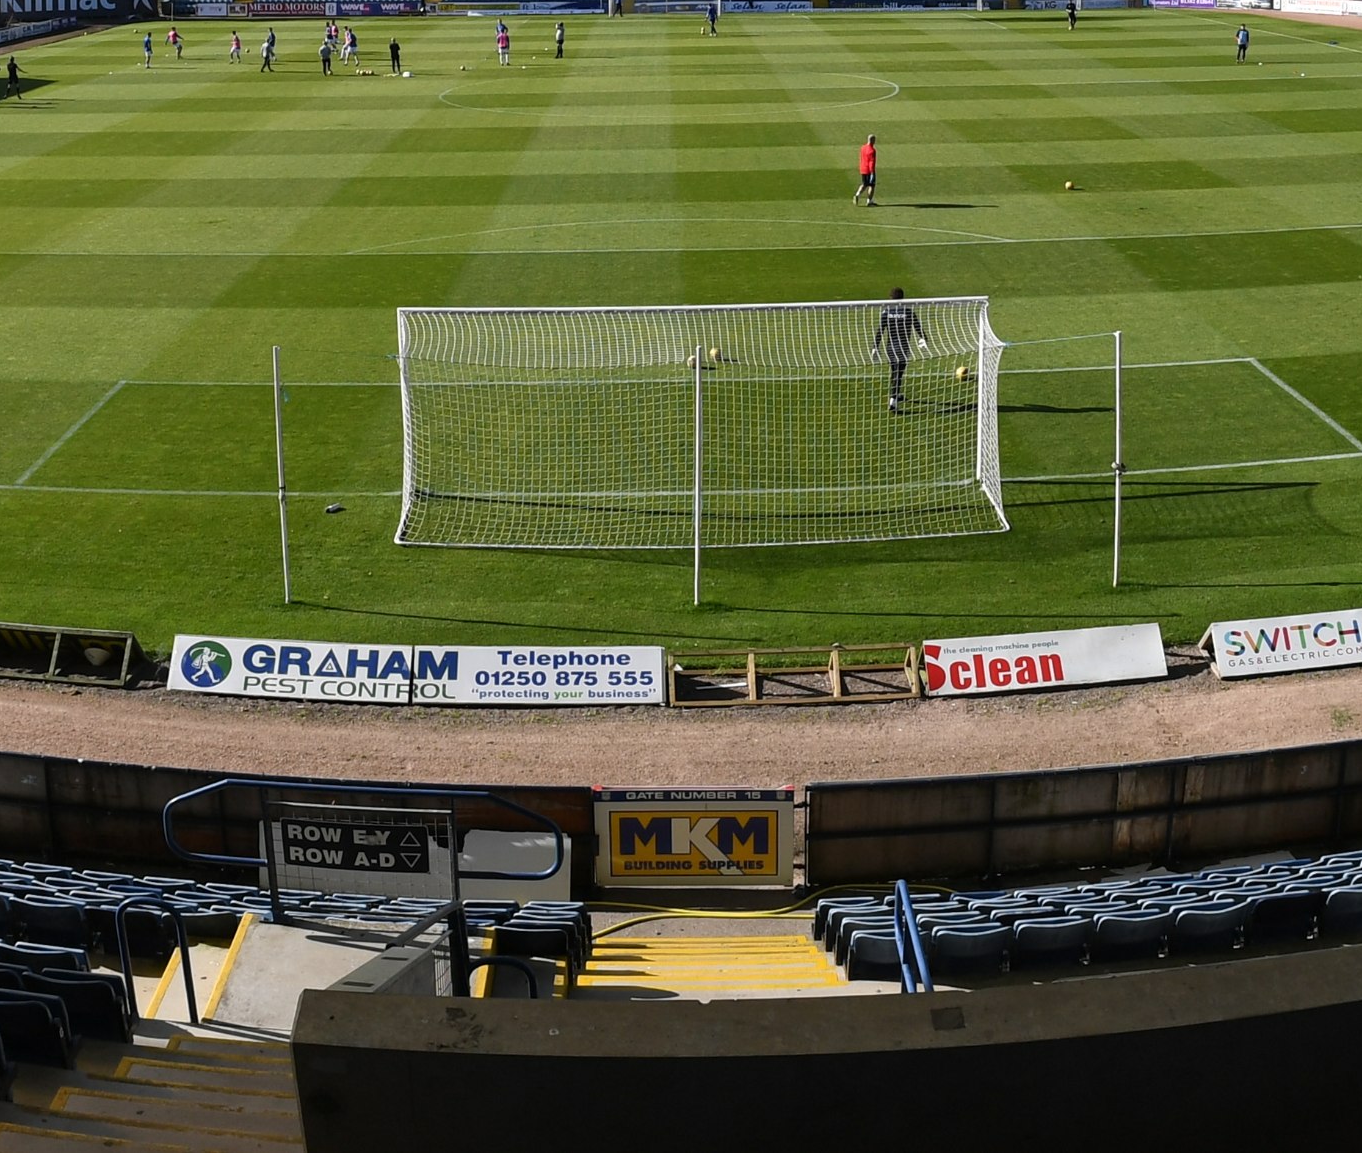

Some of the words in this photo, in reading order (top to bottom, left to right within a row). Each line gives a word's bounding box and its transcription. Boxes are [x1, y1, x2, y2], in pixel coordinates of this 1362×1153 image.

[249, 4, 283, 12] METRO
[286, 3, 325, 11] MOTORS
[1223, 619, 1360, 657] SWITCH
[943, 647, 957, 655] the
[959, 644, 993, 655] cleaning
[995, 641, 1029, 652] machine
[1031, 640, 1059, 651] people
[243, 645, 458, 680] GRAHAM
[498, 650, 631, 668] Telephone
[476, 670, 546, 687] 01250
[555, 670, 597, 686] 875
[608, 670, 654, 686] 555
[243, 677, 314, 695] PEST
[320, 679, 456, 700] CONTROL
[553, 690, 583, 701] your
[625, 791, 669, 800] GATE
[674, 791, 739, 800] NUMBER
[745, 791, 761, 800] 15
[287, 824, 342, 842] ROW
[619, 816, 770, 875] MKM
[289, 847, 344, 865] ROW
[354, 851, 395, 868] A-D
[623, 861, 694, 870] BUILDING
[698, 860, 765, 870] SUPPLIES
